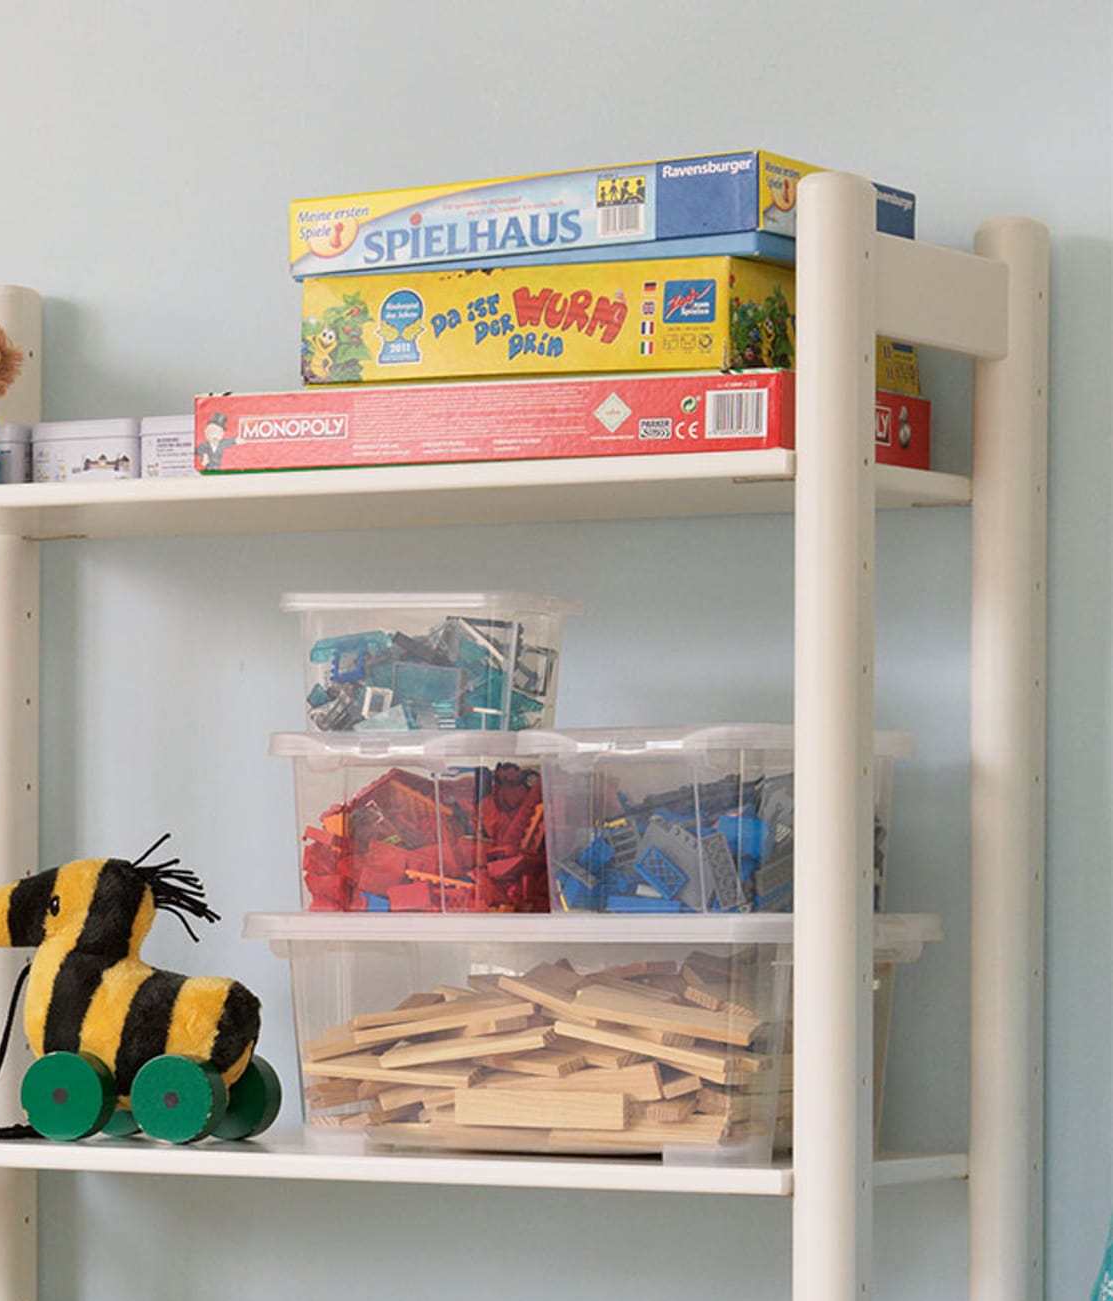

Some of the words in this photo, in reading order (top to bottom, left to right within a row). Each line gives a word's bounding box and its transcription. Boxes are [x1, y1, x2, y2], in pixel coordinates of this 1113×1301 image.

[662, 158, 752, 179] Ravensburger
[297, 209, 333, 224] Meine
[333, 206, 369, 220] ersten
[299, 225, 332, 241] Spiele
[363, 210, 583, 264] SPIELHAUS
[512, 286, 628, 344] WURM
[242, 417, 344, 438] MONOPOLY
